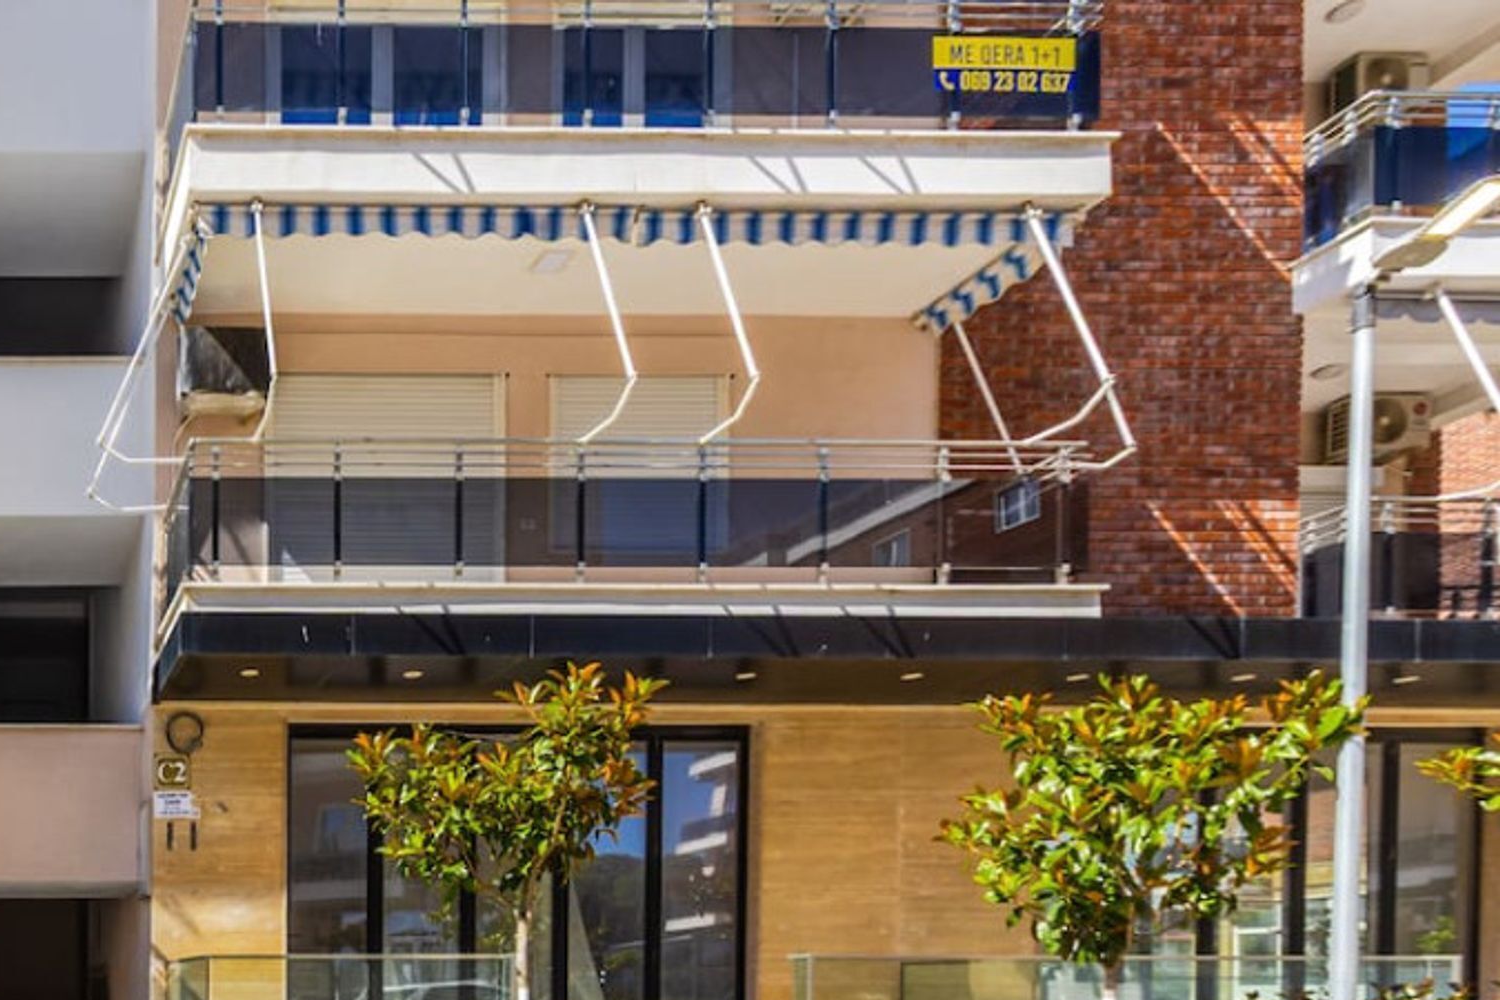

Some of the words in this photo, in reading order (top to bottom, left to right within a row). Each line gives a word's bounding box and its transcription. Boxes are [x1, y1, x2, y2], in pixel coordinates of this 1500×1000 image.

[950, 43, 974, 64] ME
[1032, 45, 1061, 67] 1+1
[994, 70, 1015, 92] 23
[158, 761, 187, 784] C2
